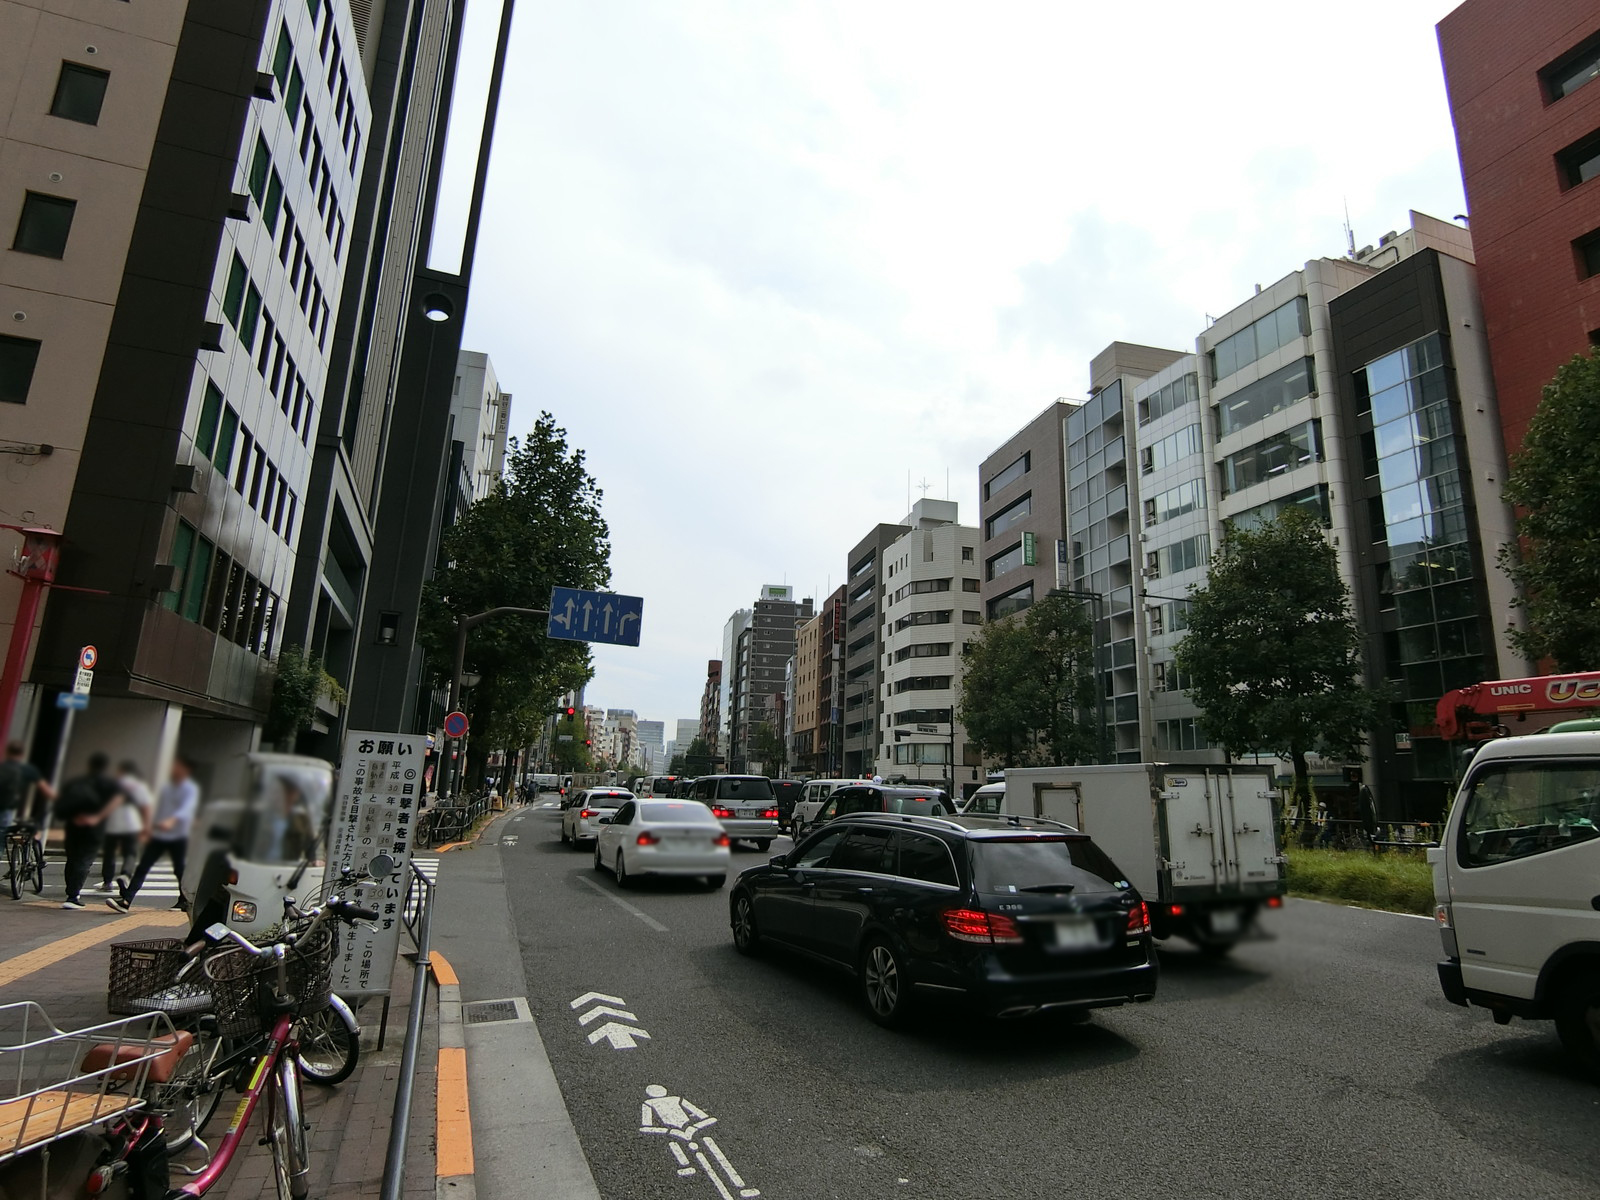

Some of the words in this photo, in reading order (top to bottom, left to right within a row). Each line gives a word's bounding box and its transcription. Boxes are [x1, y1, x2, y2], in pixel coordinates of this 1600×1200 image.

[1490, 684, 1532, 696] UNIC
[358, 739, 413, 756] お願い
